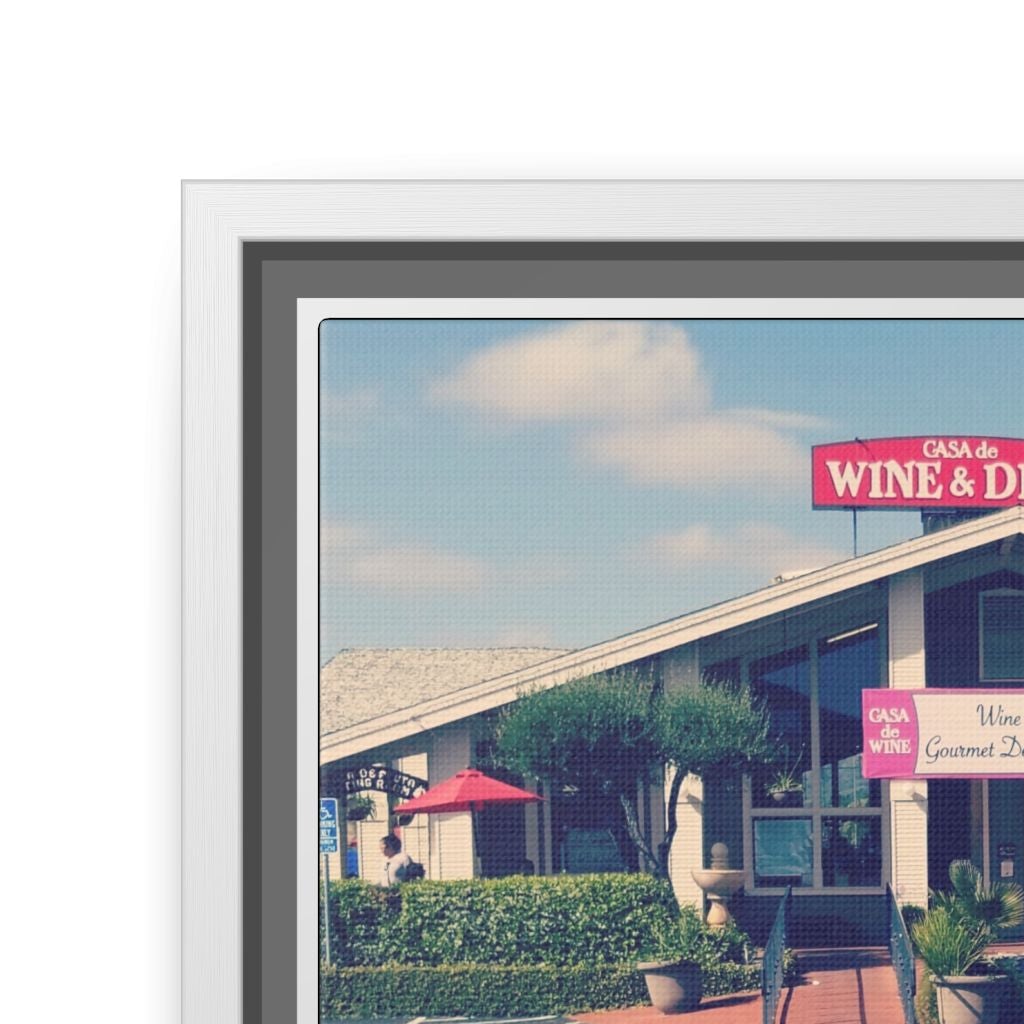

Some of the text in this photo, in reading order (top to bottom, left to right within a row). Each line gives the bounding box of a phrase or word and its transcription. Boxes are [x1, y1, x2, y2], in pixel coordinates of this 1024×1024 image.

[922, 439, 998, 459] CASA de
[826, 459, 943, 500] WINE
[949, 466, 974, 497] &
[868, 708, 910, 723] CASA
[976, 704, 1021, 727] Wine
[880, 724, 900, 739] de
[868, 739, 911, 754] WINE
[925, 735, 995, 764] Gourmet
